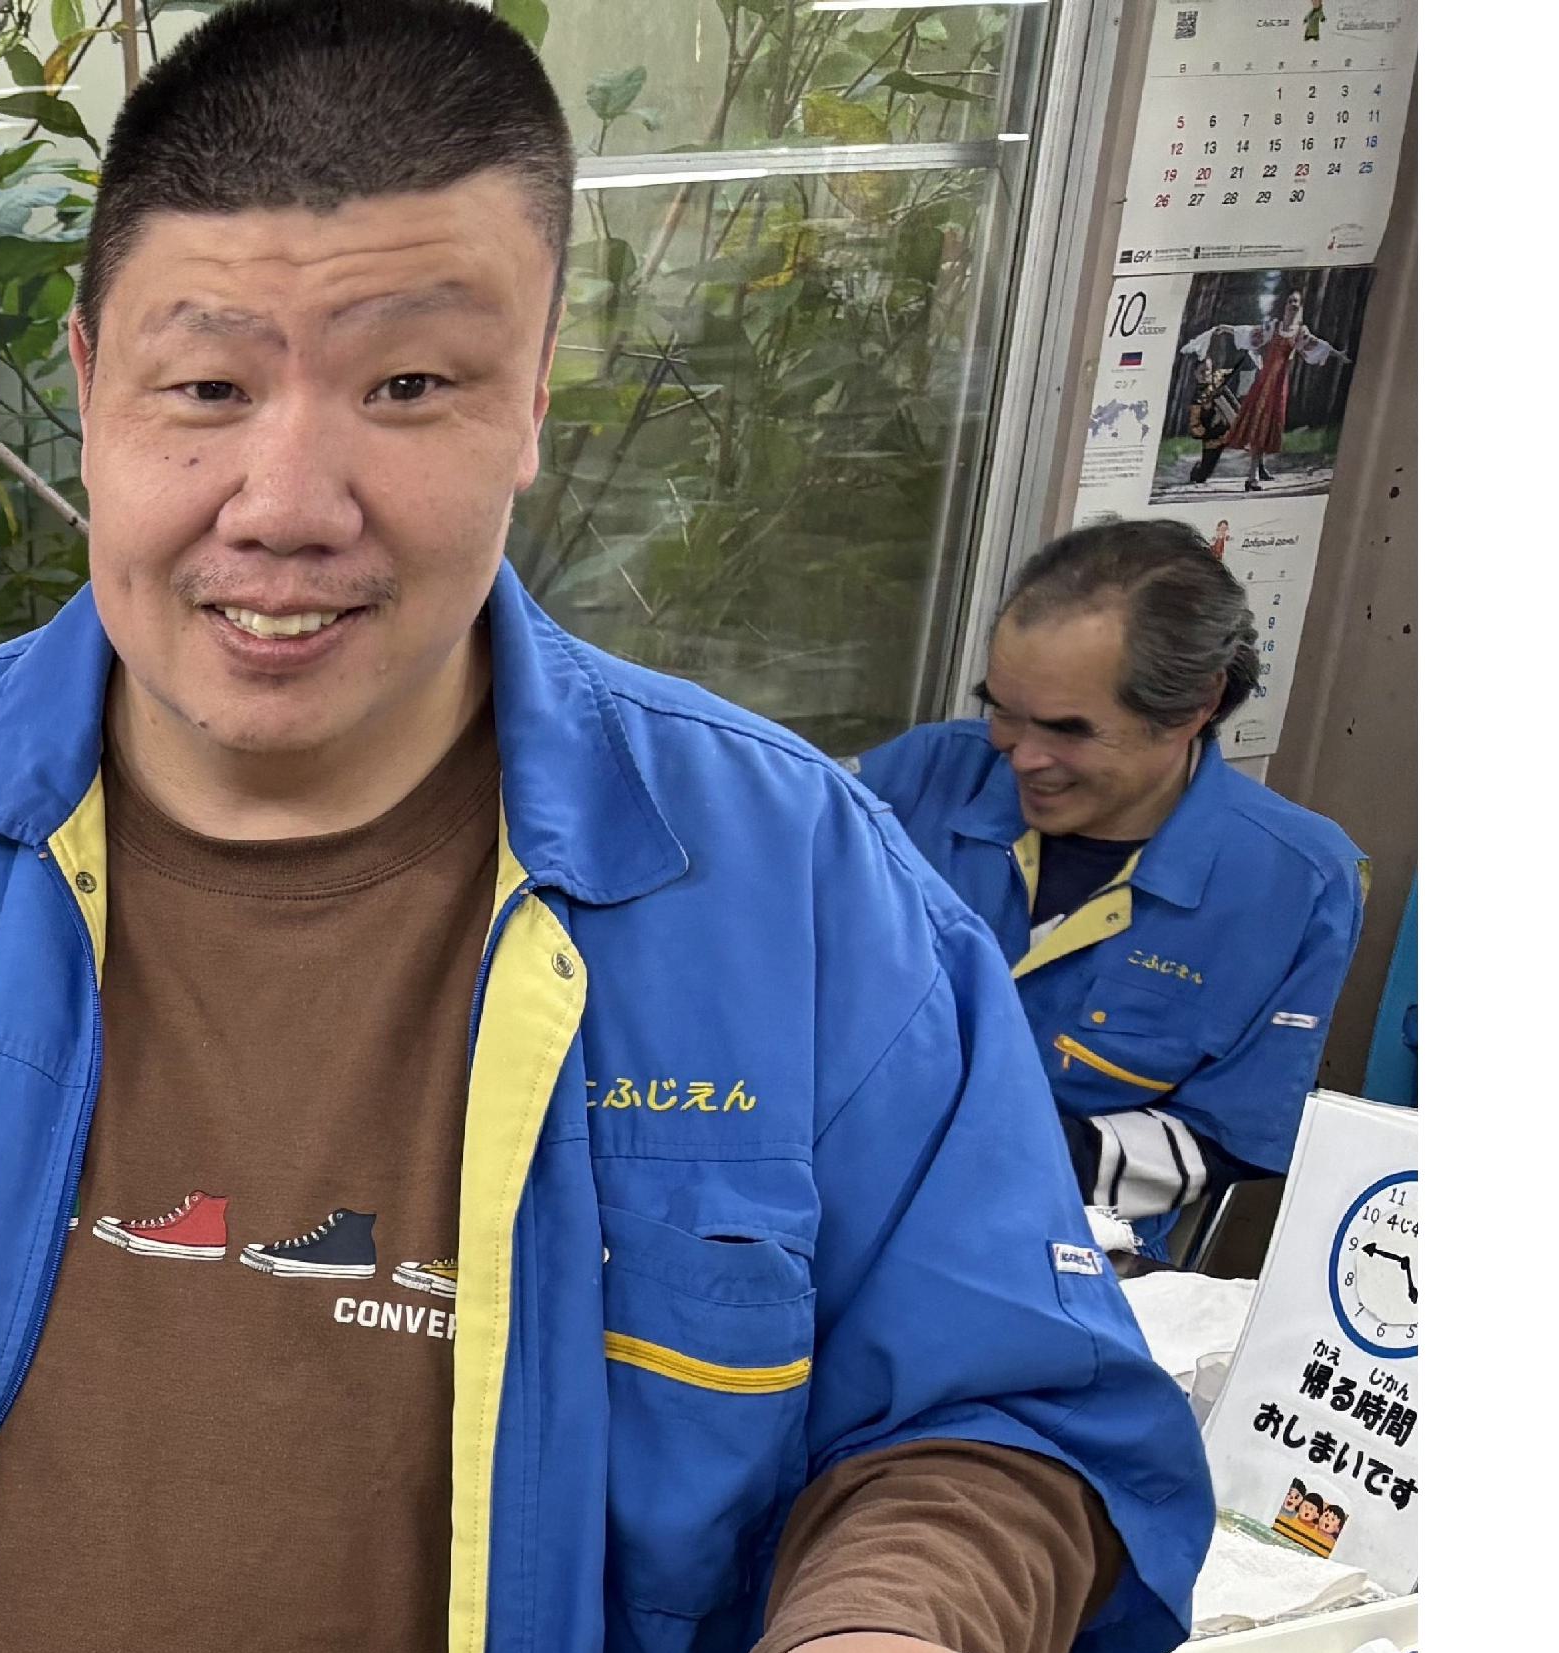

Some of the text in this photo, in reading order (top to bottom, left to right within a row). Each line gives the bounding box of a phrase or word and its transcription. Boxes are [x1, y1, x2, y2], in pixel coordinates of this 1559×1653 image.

[1109, 291, 1146, 337] 10
[1389, 1188, 1406, 1206] 11
[1362, 1206, 1380, 1224] 10
[1349, 1237, 1358, 1250] 9
[1345, 1272, 1354, 1286] 8
[1355, 1302, 1365, 1317] 7
[1377, 1323, 1417, 1338] 6 5
[1313, 1339, 1341, 1366] かえ
[1369, 1368, 1409, 1401] じかん
[1299, 1360, 1417, 1447] 帰る時間
[1253, 1403, 1418, 1510] おしまいです
